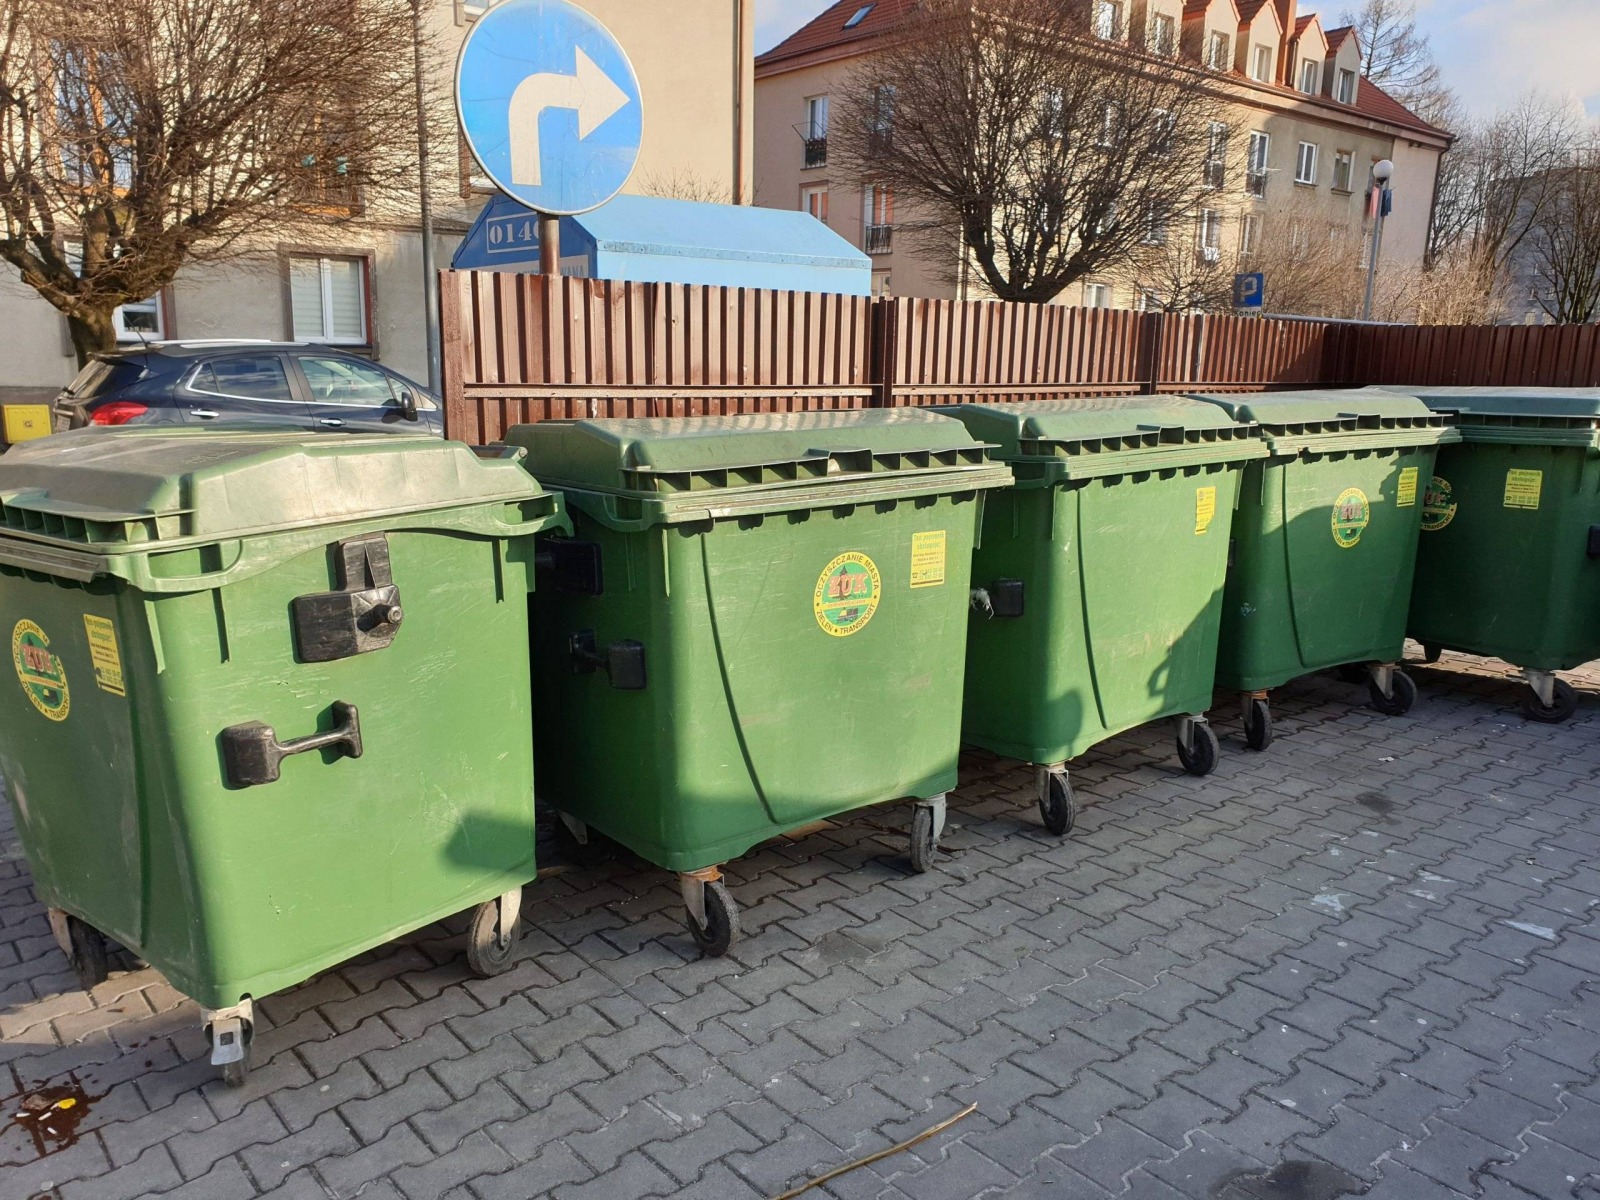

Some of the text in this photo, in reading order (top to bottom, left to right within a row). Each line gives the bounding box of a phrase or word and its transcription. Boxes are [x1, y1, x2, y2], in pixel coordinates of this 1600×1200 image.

[815, 554, 864, 597] OCZYSZCZANIE
[863, 559, 880, 591] MIASTA
[840, 603, 876, 634] TRANSPORT
